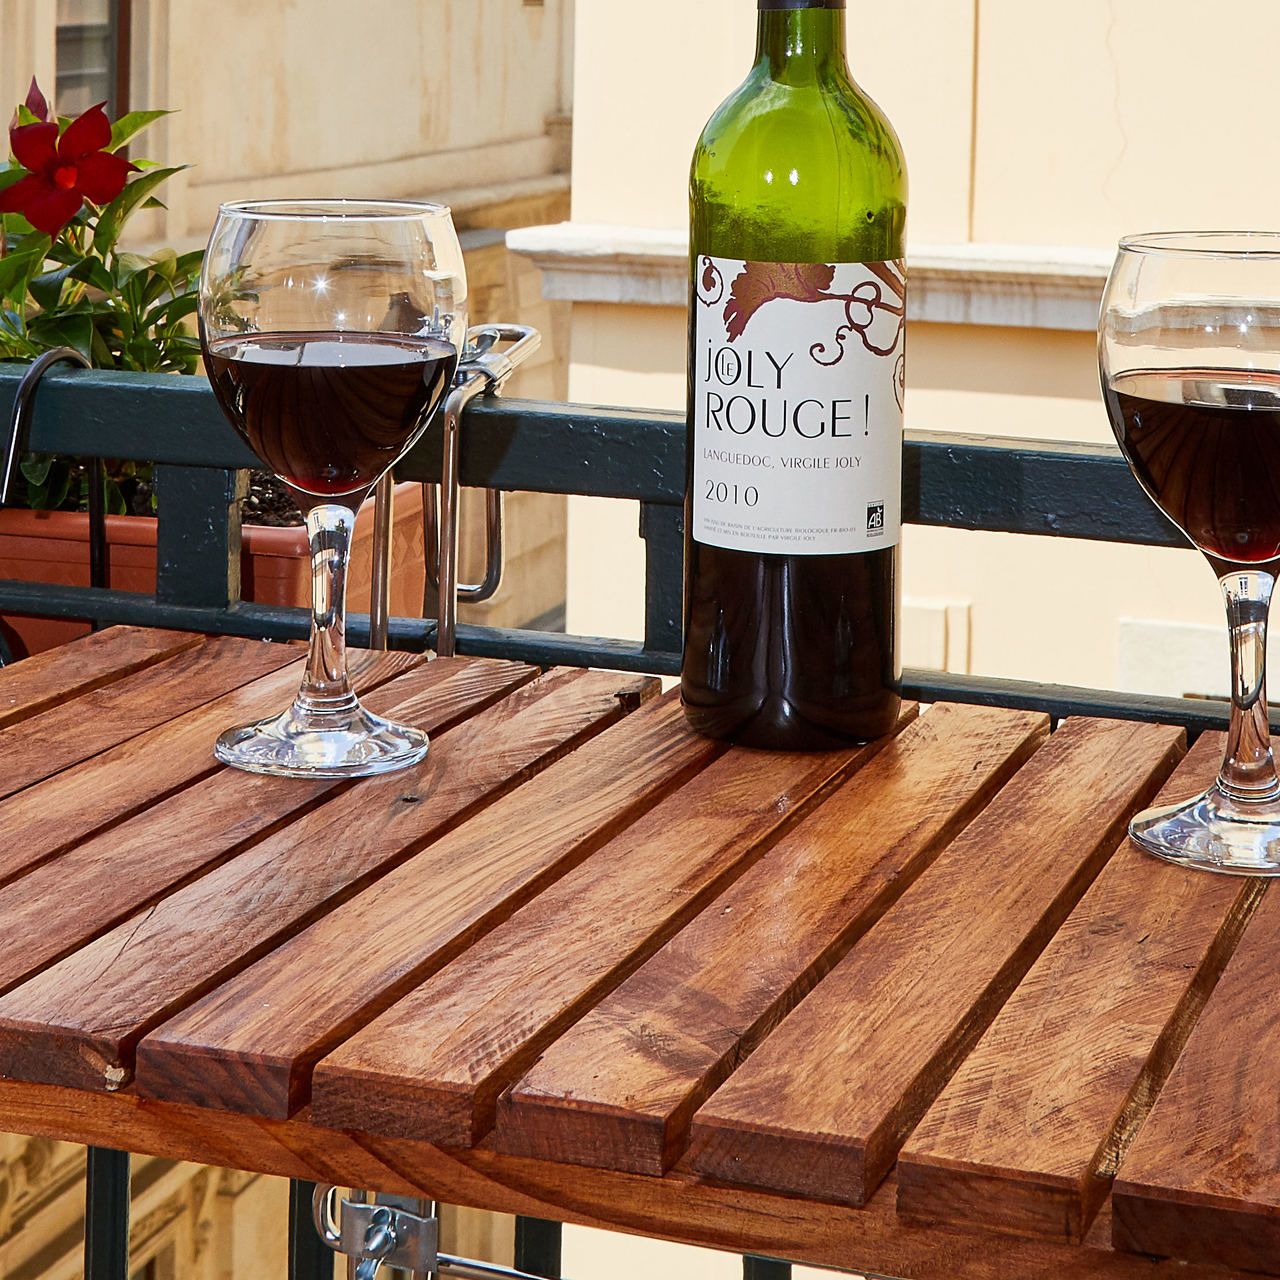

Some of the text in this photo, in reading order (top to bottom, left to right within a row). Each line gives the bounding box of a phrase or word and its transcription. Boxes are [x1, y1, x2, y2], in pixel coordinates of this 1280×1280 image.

[706, 391, 852, 439] ROUGE
[703, 447, 862, 469] LANGUEDOC, VIRGILE JOLY
[705, 479, 759, 507] 2010
